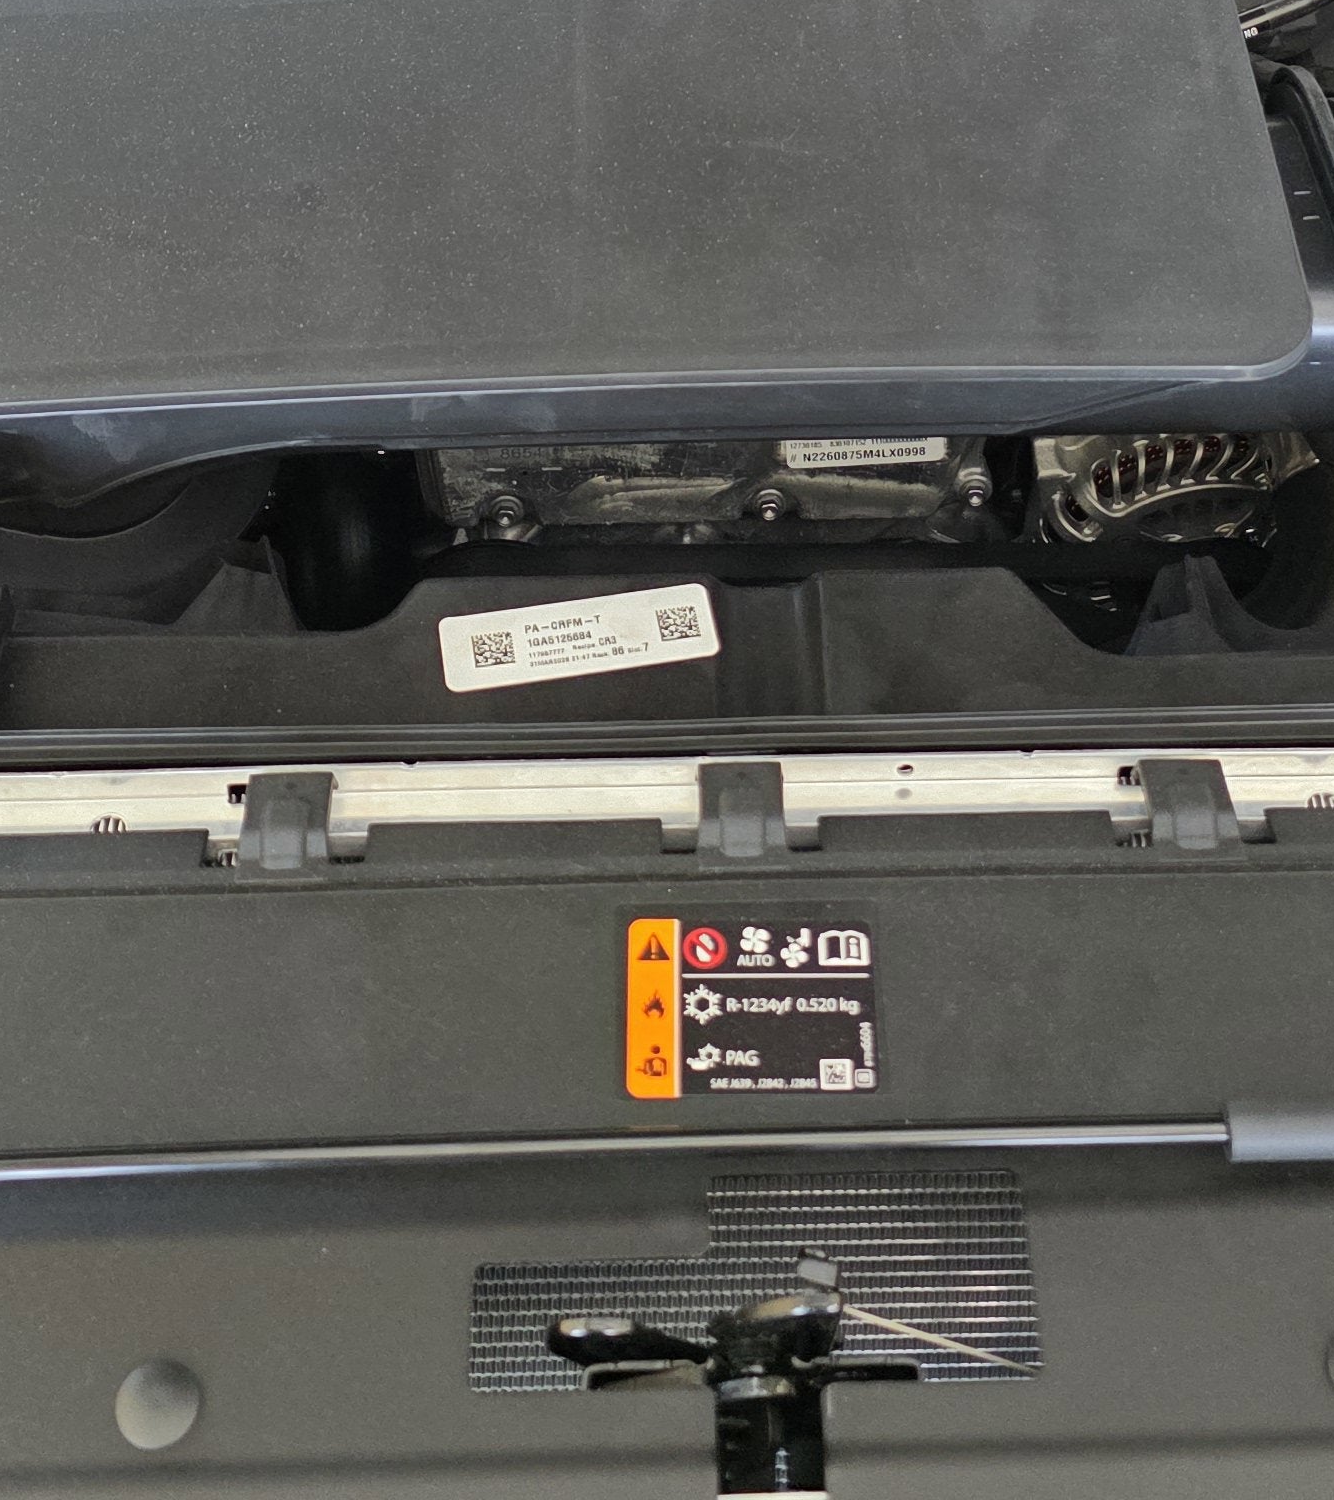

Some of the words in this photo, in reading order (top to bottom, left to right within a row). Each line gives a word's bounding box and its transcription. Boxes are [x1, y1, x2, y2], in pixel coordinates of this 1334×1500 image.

[803, 447, 926, 463] N2260875M4LX0998
[598, 635, 618, 647] CR3
[642, 642, 650, 653] 7
[736, 954, 776, 967] AUTO
[725, 996, 793, 1015] R-1234yf
[795, 997, 838, 1013] 0.520
[839, 997, 862, 1016] kg
[725, 1050, 760, 1066] PAG
[709, 1078, 729, 1089] SAE
